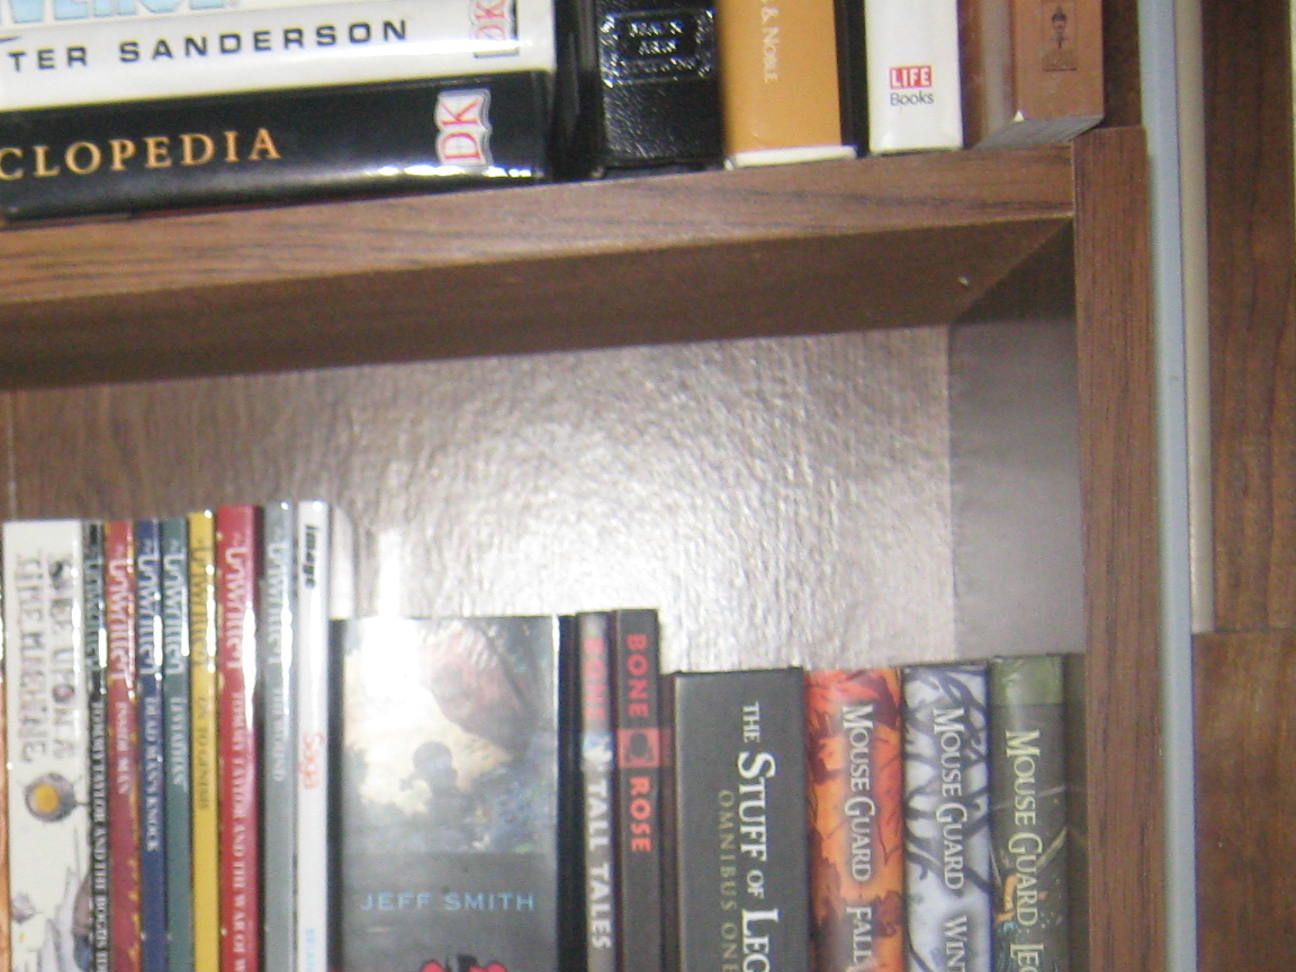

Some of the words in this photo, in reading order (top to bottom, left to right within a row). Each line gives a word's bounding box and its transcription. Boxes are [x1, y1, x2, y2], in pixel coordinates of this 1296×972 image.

[119, 20, 410, 62] SANDERSON
[891, 66, 932, 89] LIFE
[441, 98, 482, 160] DK
[890, 92, 935, 107] Books
[582, 636, 605, 721] BONE
[626, 633, 648, 718] BONE
[300, 731, 325, 791] Saga
[742, 701, 761, 743] THE
[842, 704, 874, 793] MOUSE
[931, 707, 967, 798] MOUSE
[587, 778, 609, 851] TALL
[630, 775, 651, 853] ROSE
[737, 751, 777, 862] STUFF
[1004, 728, 1041, 825] MOUSE
[717, 789, 738, 912] OMNIBUS
[845, 796, 876, 882] GUARD
[935, 801, 968, 891] GUARD
[360, 891, 433, 912] JEFF
[443, 891, 535, 911] SMITH
[590, 861, 612, 950] TALES
[746, 869, 765, 900] OF
[846, 905, 874, 958] FALL
